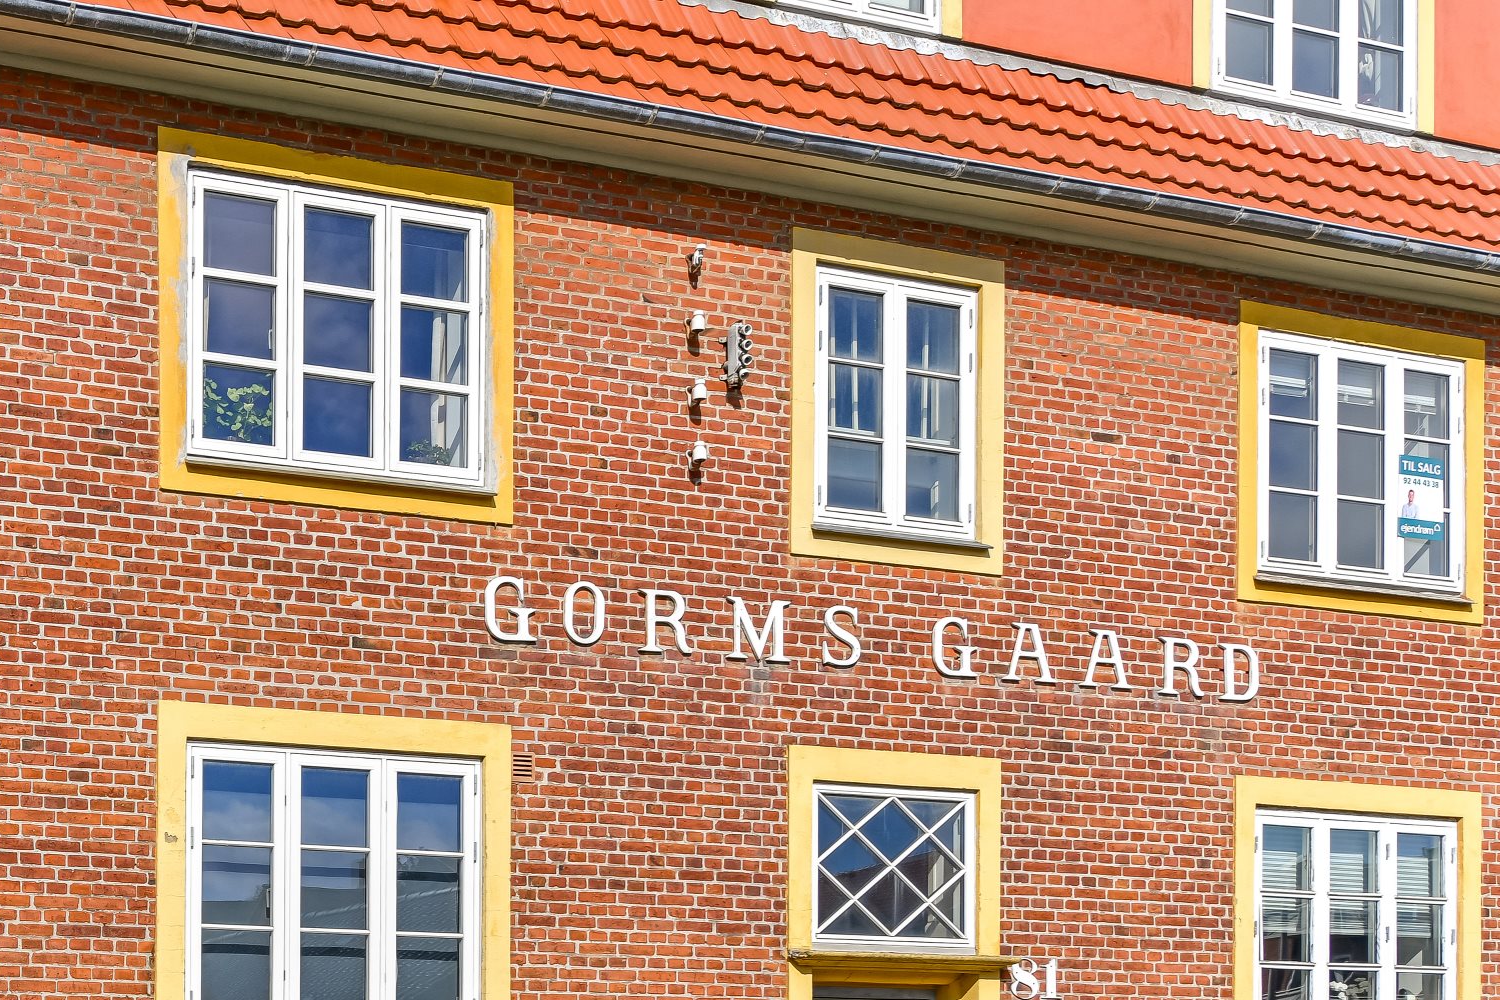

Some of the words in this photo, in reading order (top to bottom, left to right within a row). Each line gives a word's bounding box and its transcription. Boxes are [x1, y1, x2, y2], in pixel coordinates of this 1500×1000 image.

[1402, 460, 1416, 471] TIL
[1418, 462, 1441, 475] SALG
[483, 575, 862, 668] GORMS
[932, 616, 1260, 703] GAARD
[1010, 957, 1063, 1000] 81
